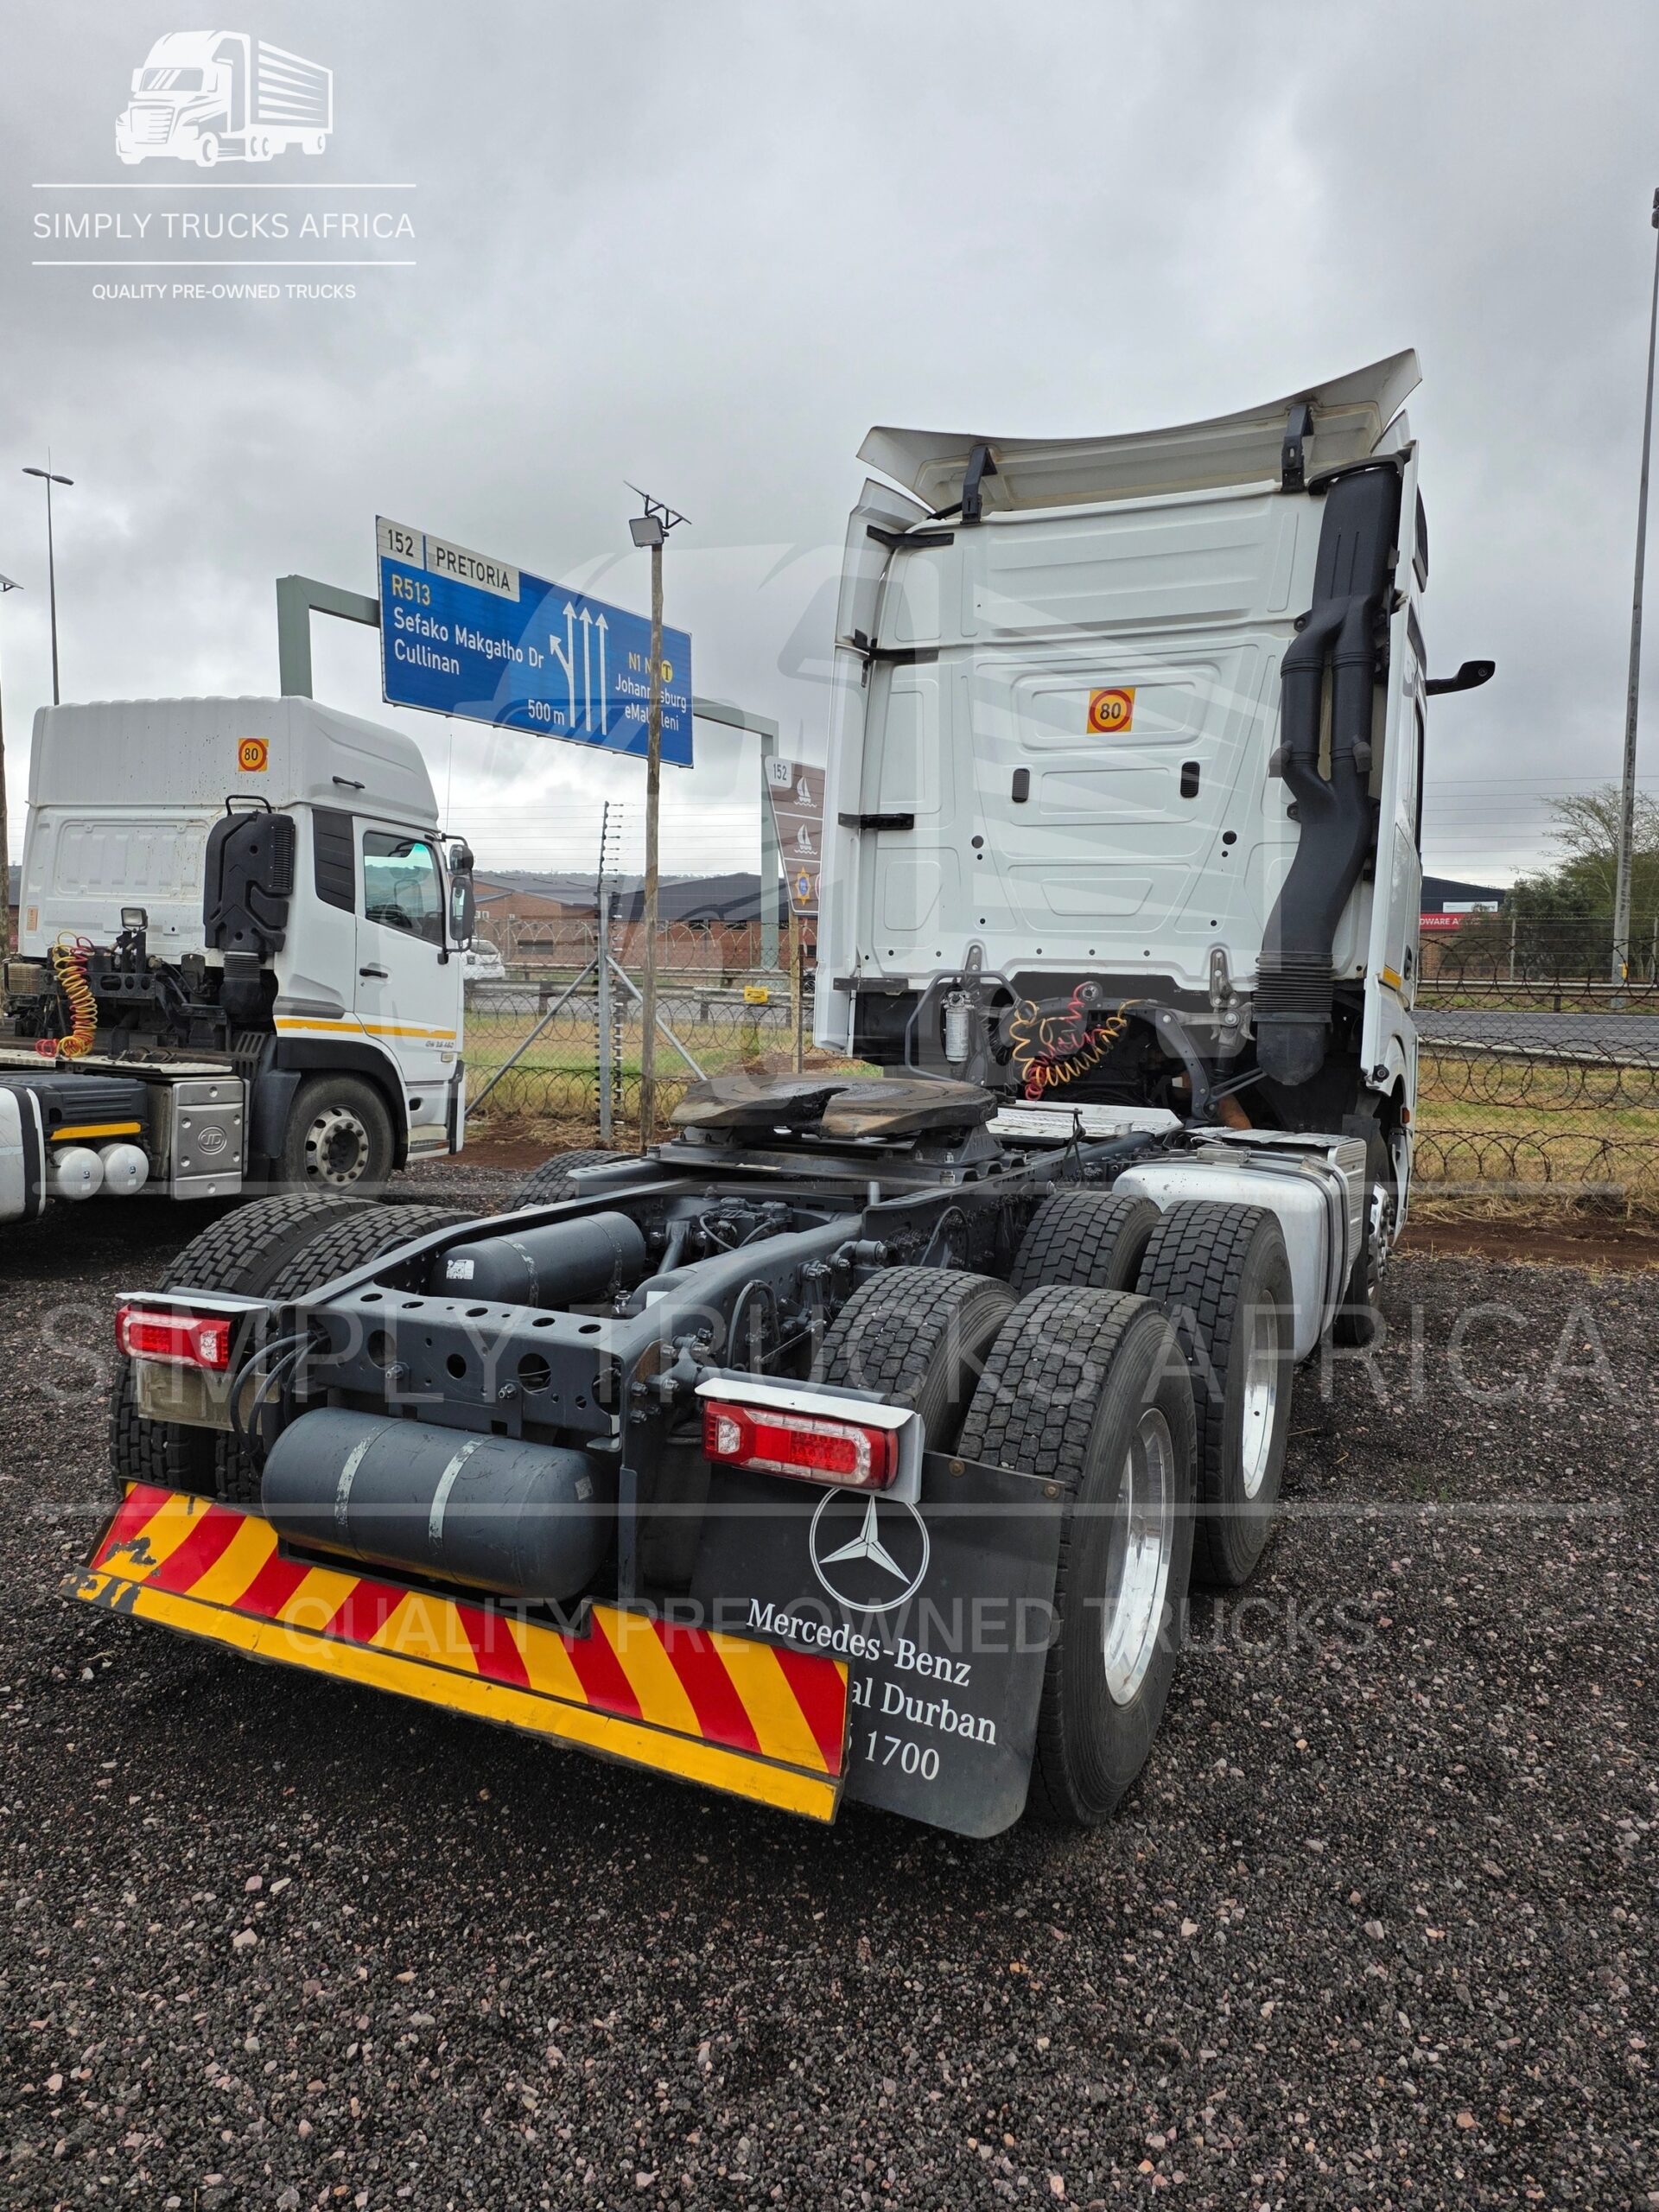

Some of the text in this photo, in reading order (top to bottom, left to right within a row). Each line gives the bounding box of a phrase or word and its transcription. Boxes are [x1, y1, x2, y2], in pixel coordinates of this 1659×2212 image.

[388, 529, 511, 592] 152 PRETORIA
[391, 574, 430, 606] R513
[394, 607, 544, 669] Sefako Makgatho Dr
[394, 638, 460, 676] Cullinan
[628, 651, 640, 672] N1
[527, 698, 565, 725] 500 m
[625, 702, 679, 731] eMalleni
[1100, 702, 1121, 720] 80
[245, 747, 258, 760] 80
[773, 763, 787, 781] 152
[746, 1598, 972, 1687] Mercedes-Benz
[880, 1681, 996, 1745] Durban
[864, 1730, 940, 1781] 1700
